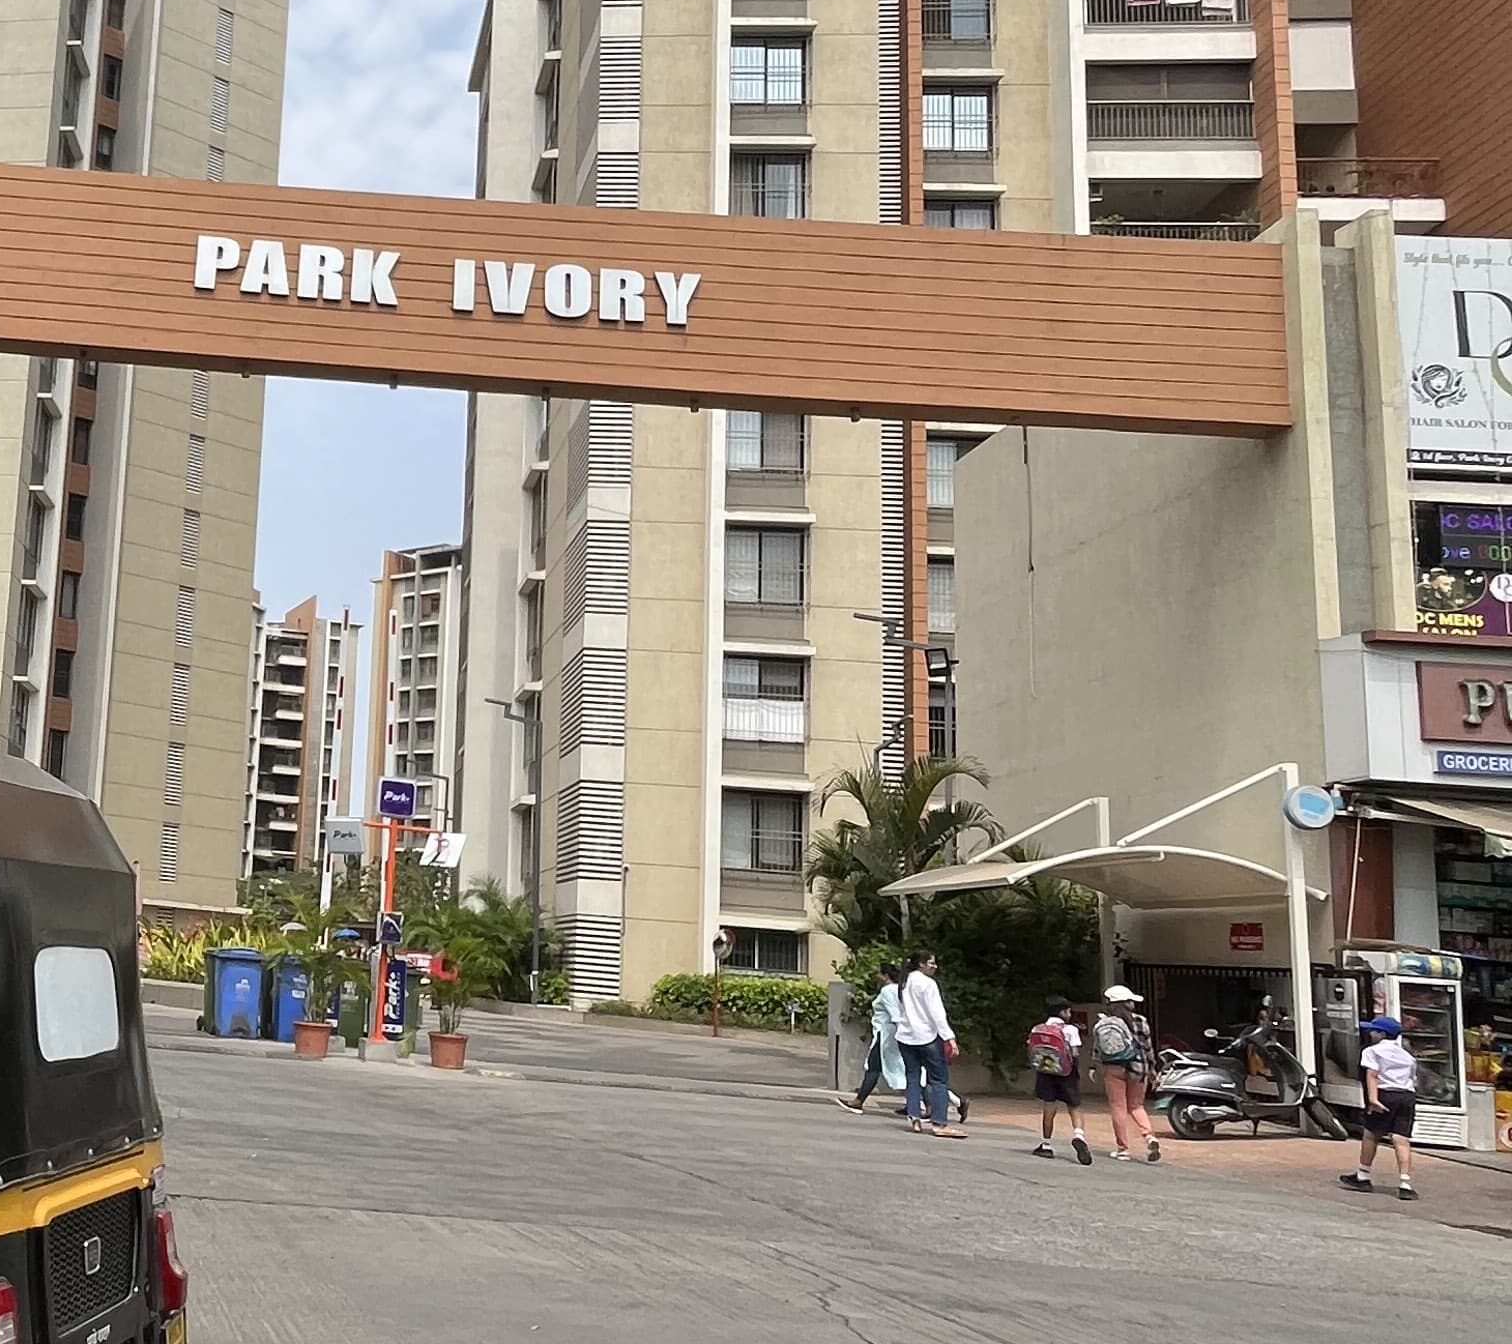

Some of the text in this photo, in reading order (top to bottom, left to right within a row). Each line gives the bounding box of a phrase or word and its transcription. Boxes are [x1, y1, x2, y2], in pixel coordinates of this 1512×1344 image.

[193, 234, 702, 325] PARK IVORY
[1445, 419, 1487, 428] SALON
[1439, 613, 1484, 628] MENS
